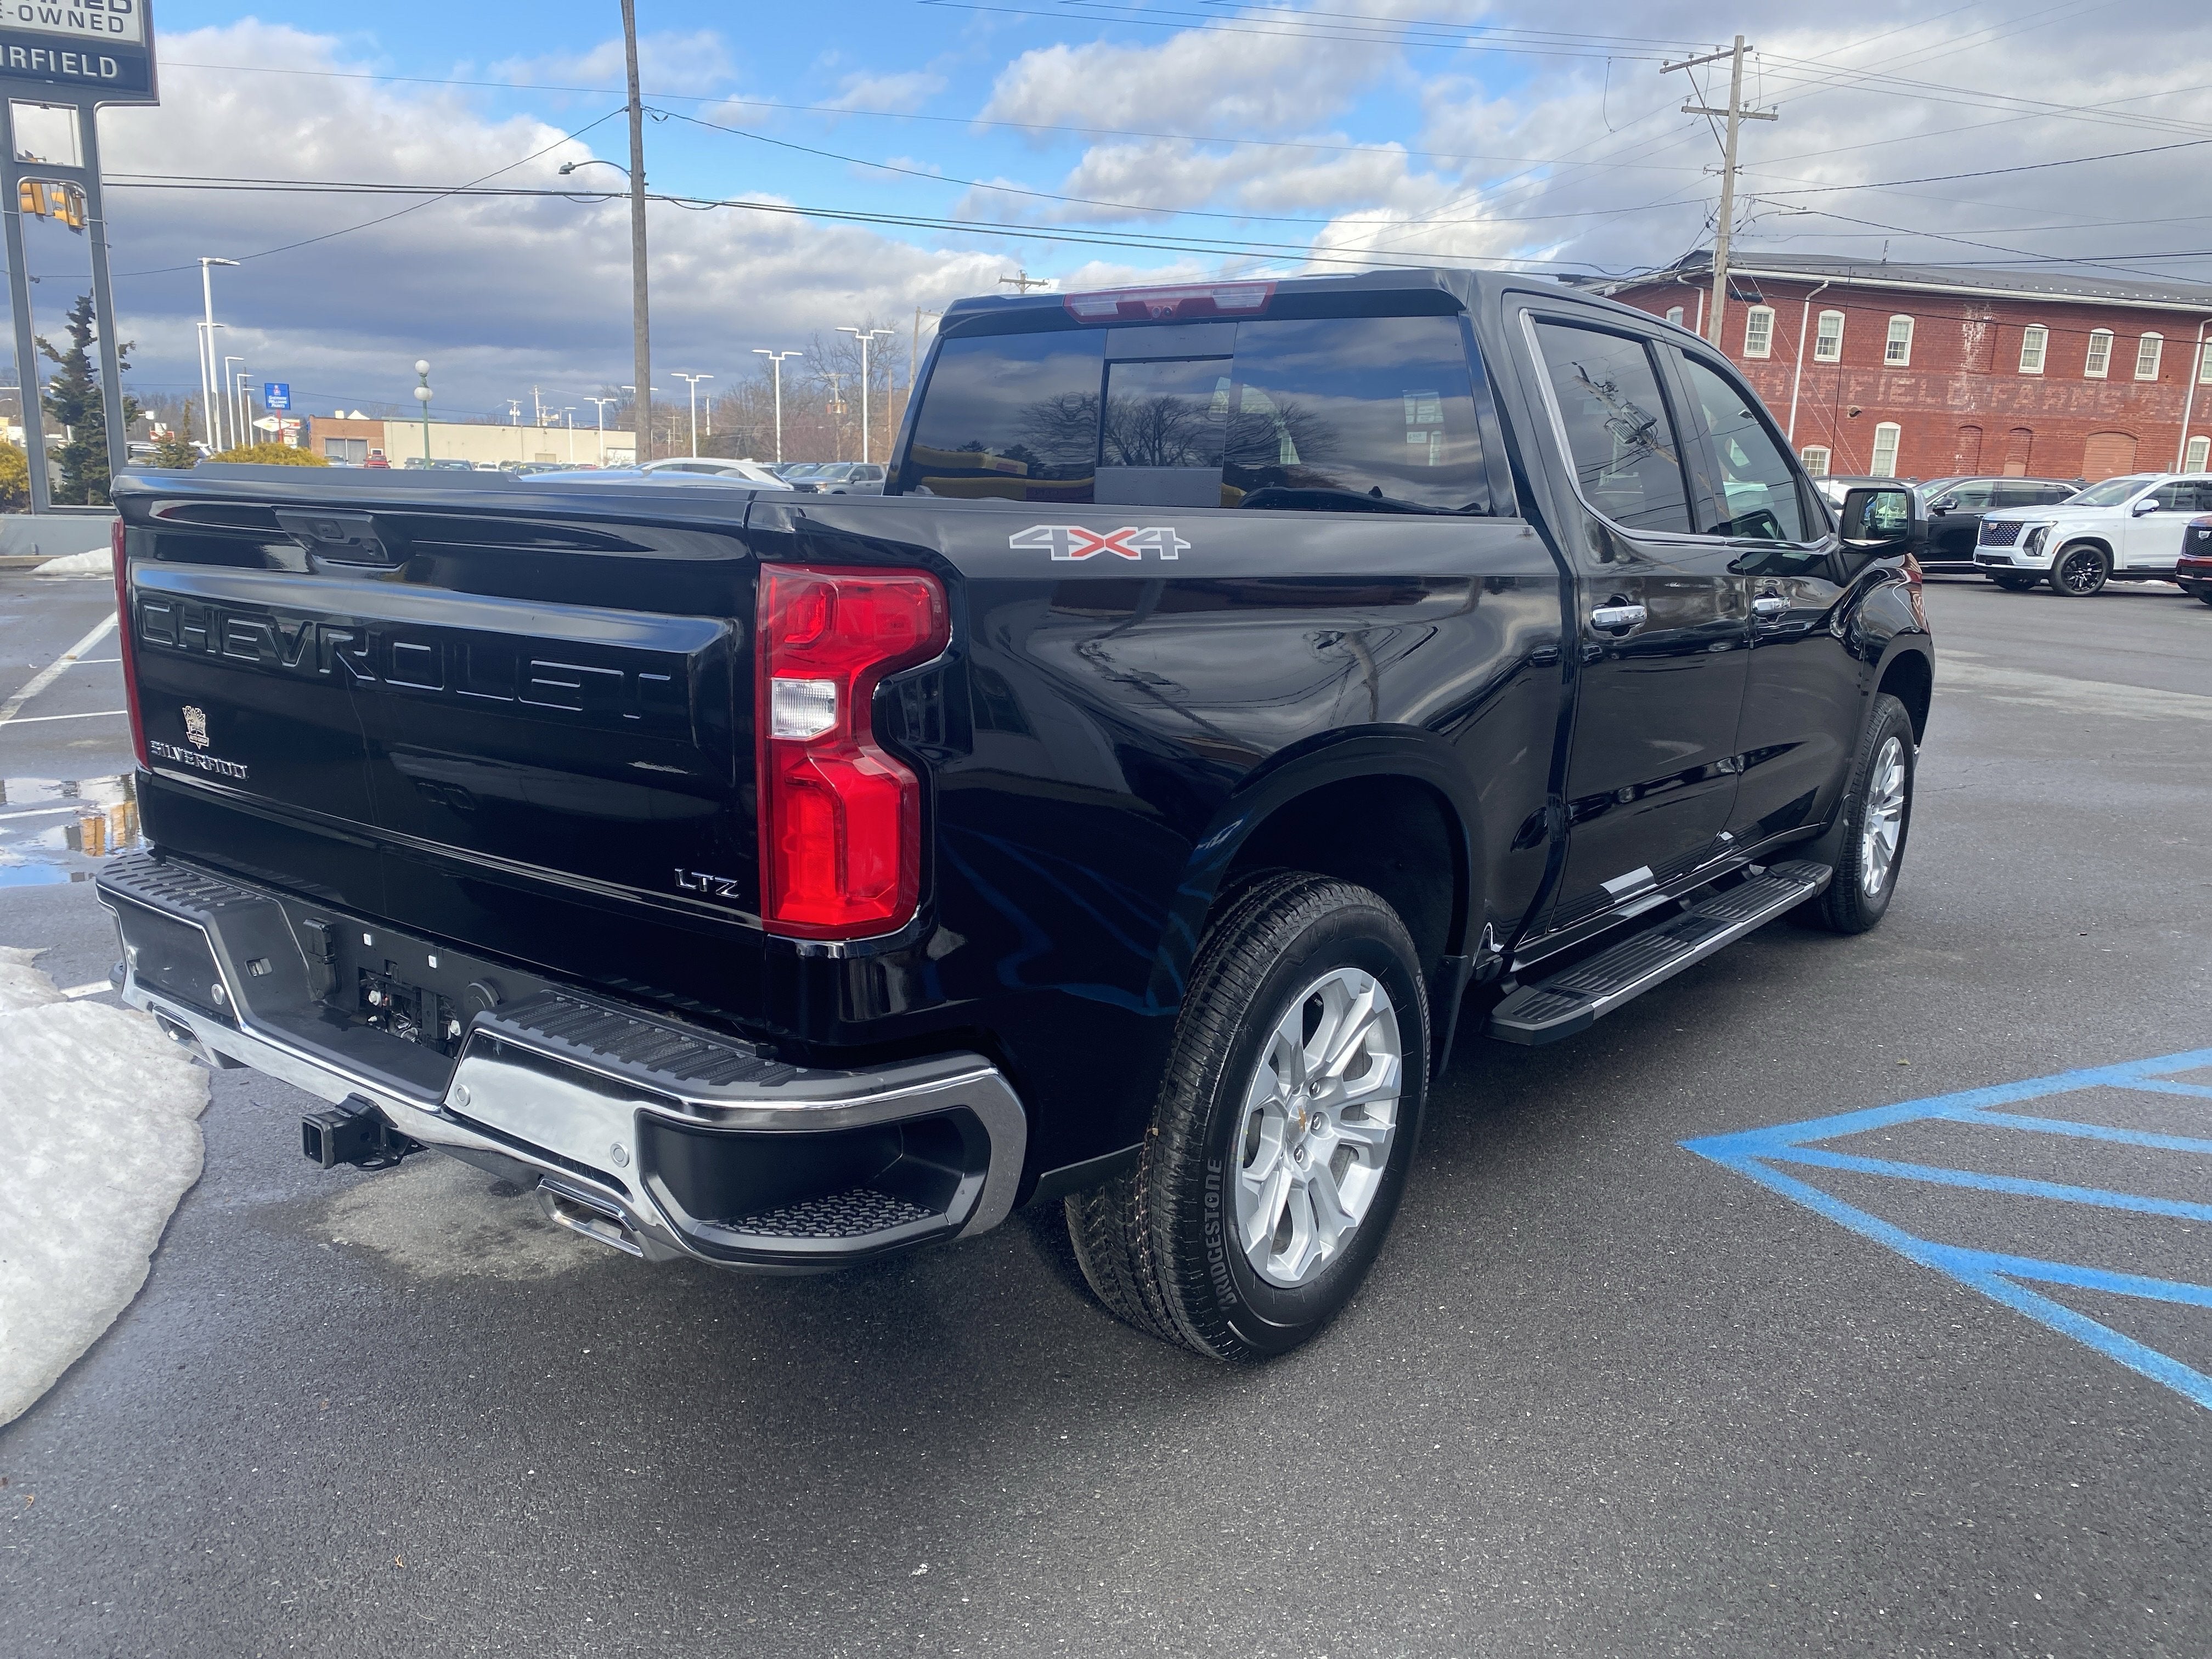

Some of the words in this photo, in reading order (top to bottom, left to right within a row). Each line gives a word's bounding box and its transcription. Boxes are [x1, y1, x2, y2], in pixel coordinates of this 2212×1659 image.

[0, 2, 123, 33] -OWNED
[140, 601, 672, 720] CHEVROLET
[150, 740, 248, 780] SILVERADO
[674, 868, 740, 898] LTZ
[1204, 1158, 1238, 1312] BRIDGESTONE
